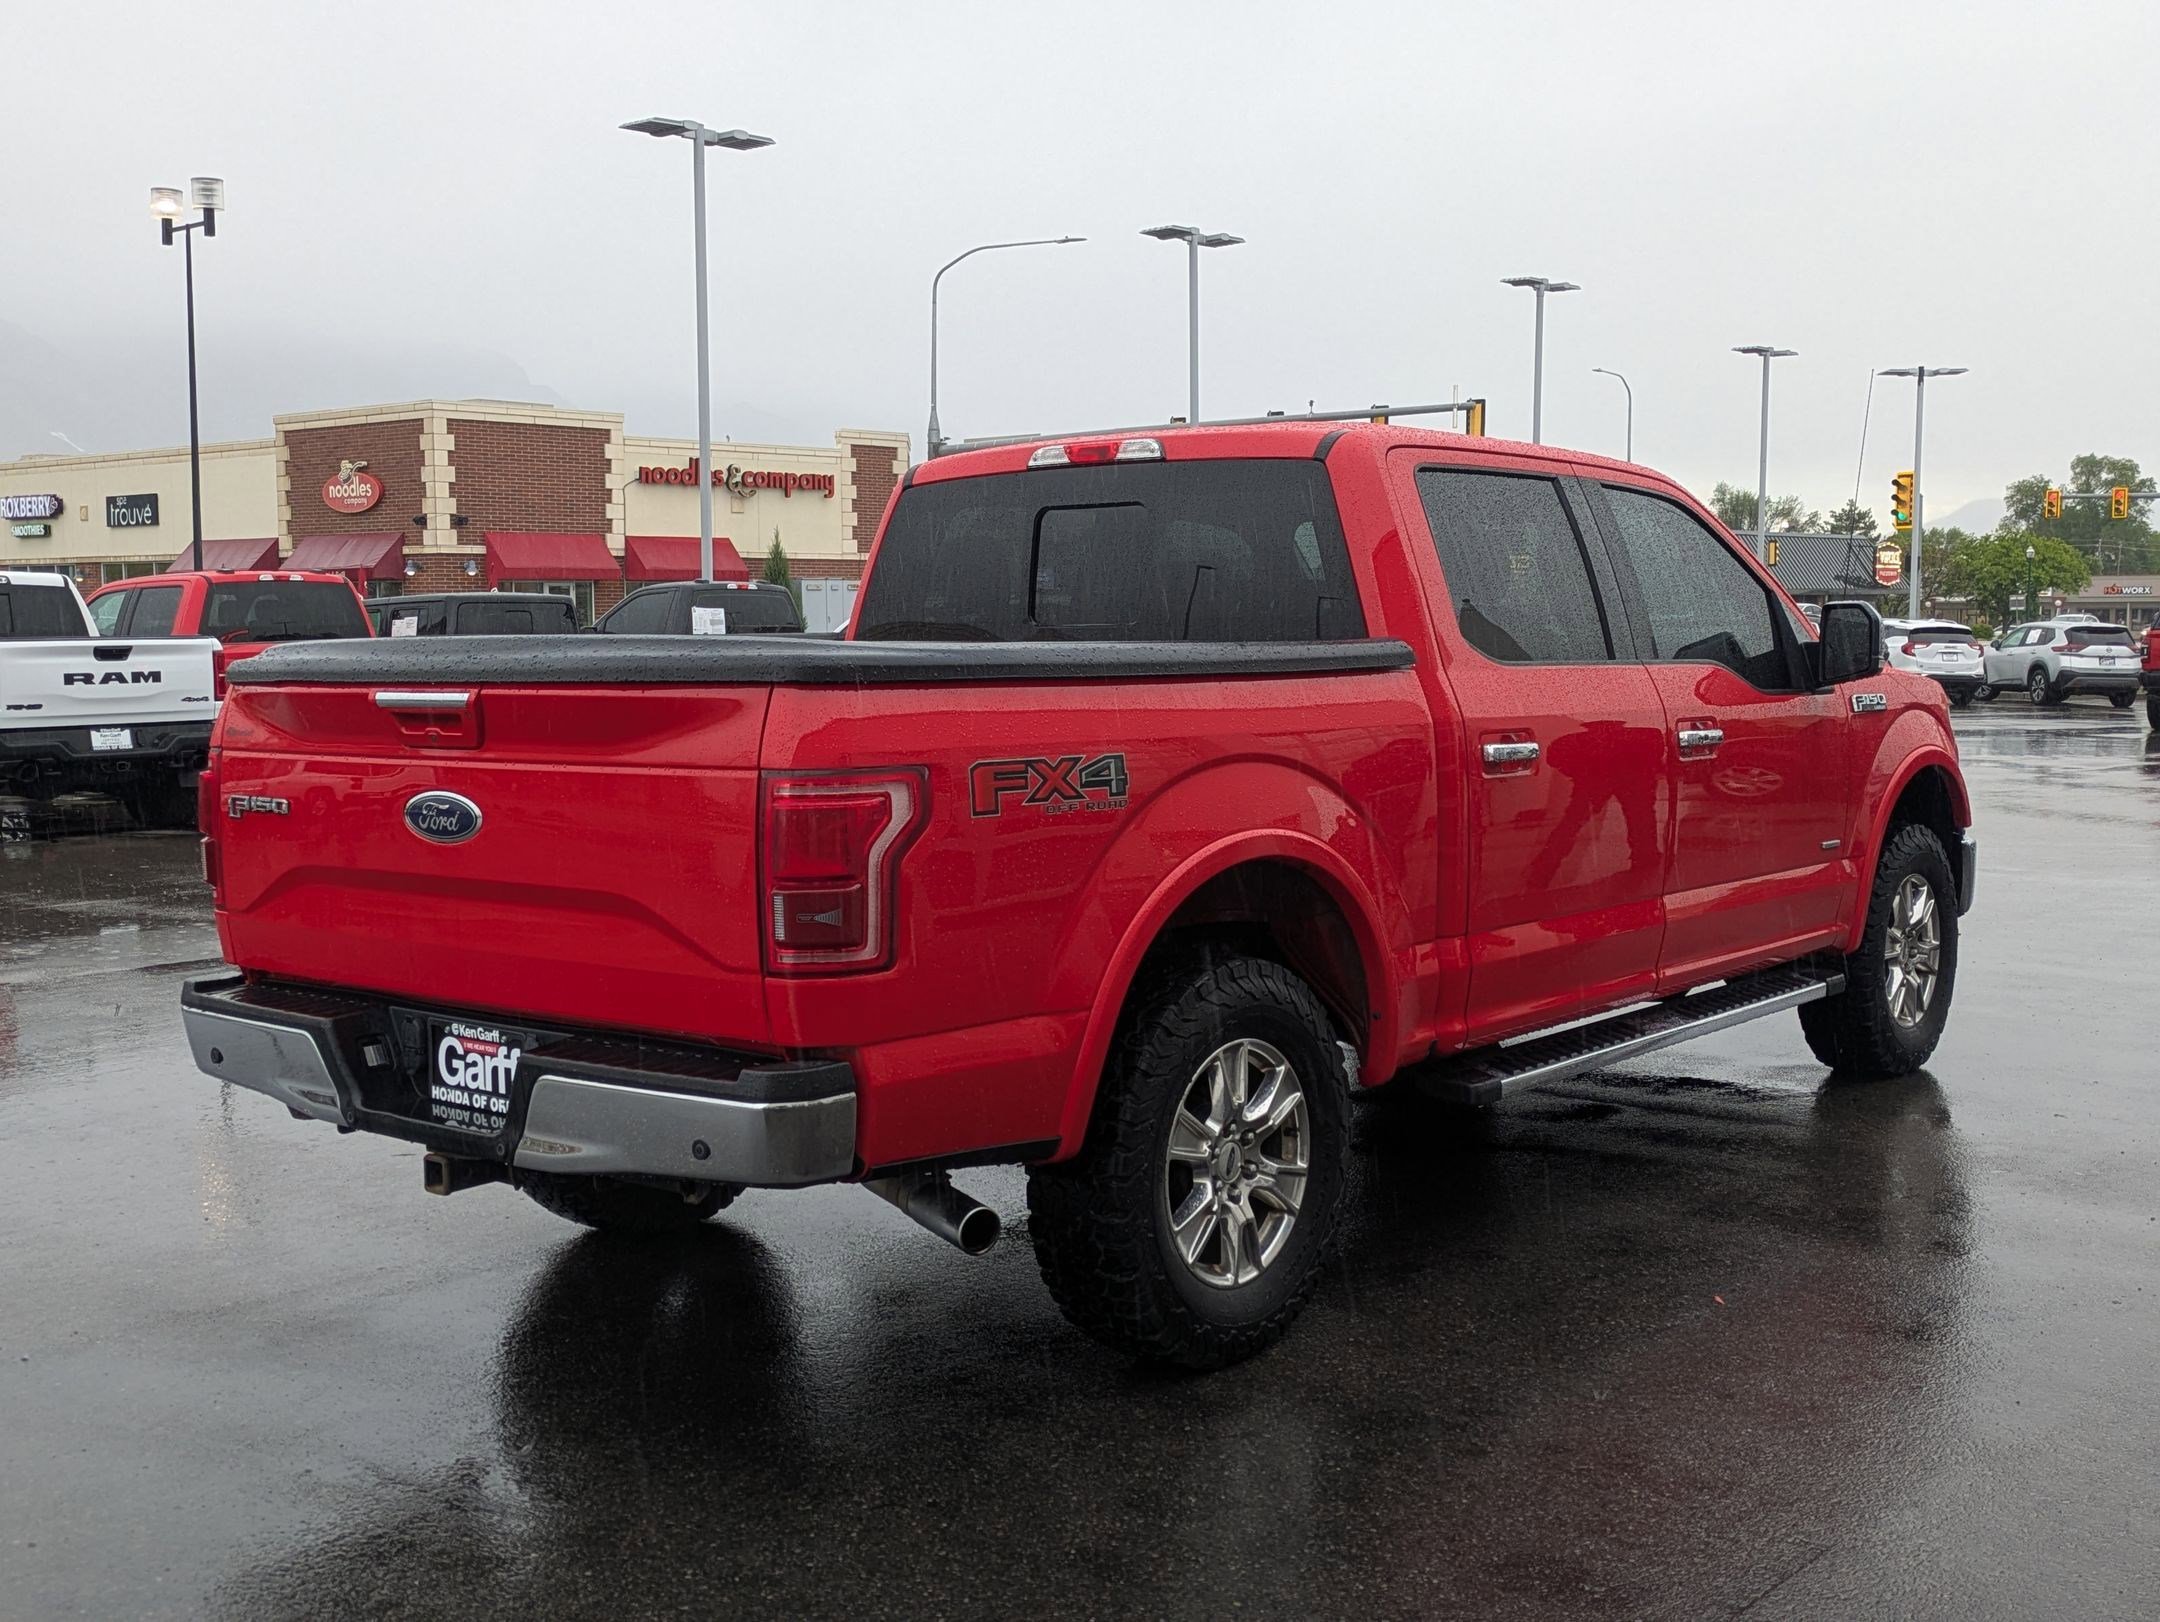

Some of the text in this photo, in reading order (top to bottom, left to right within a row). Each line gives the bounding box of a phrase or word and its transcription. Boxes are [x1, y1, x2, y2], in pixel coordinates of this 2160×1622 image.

[329, 475, 372, 498] noodles
[742, 470, 835, 498] company
[0, 496, 51, 518] ROXBERRY
[11, 524, 45, 536] SMOOTHIES
[2104, 584, 2152, 594] HOTWORX
[64, 671, 162, 685] RAM
[969, 752, 1129, 818] FX4
[228, 795, 289, 817] F150
[418, 801, 461, 832] Ford
[1046, 799, 1128, 814] OFF ROAD
[459, 1024, 500, 1043] Ken Garff
[438, 1036, 520, 1094] Garff
[432, 1085, 470, 1106] HONDA
[472, 1094, 487, 1109] OF
